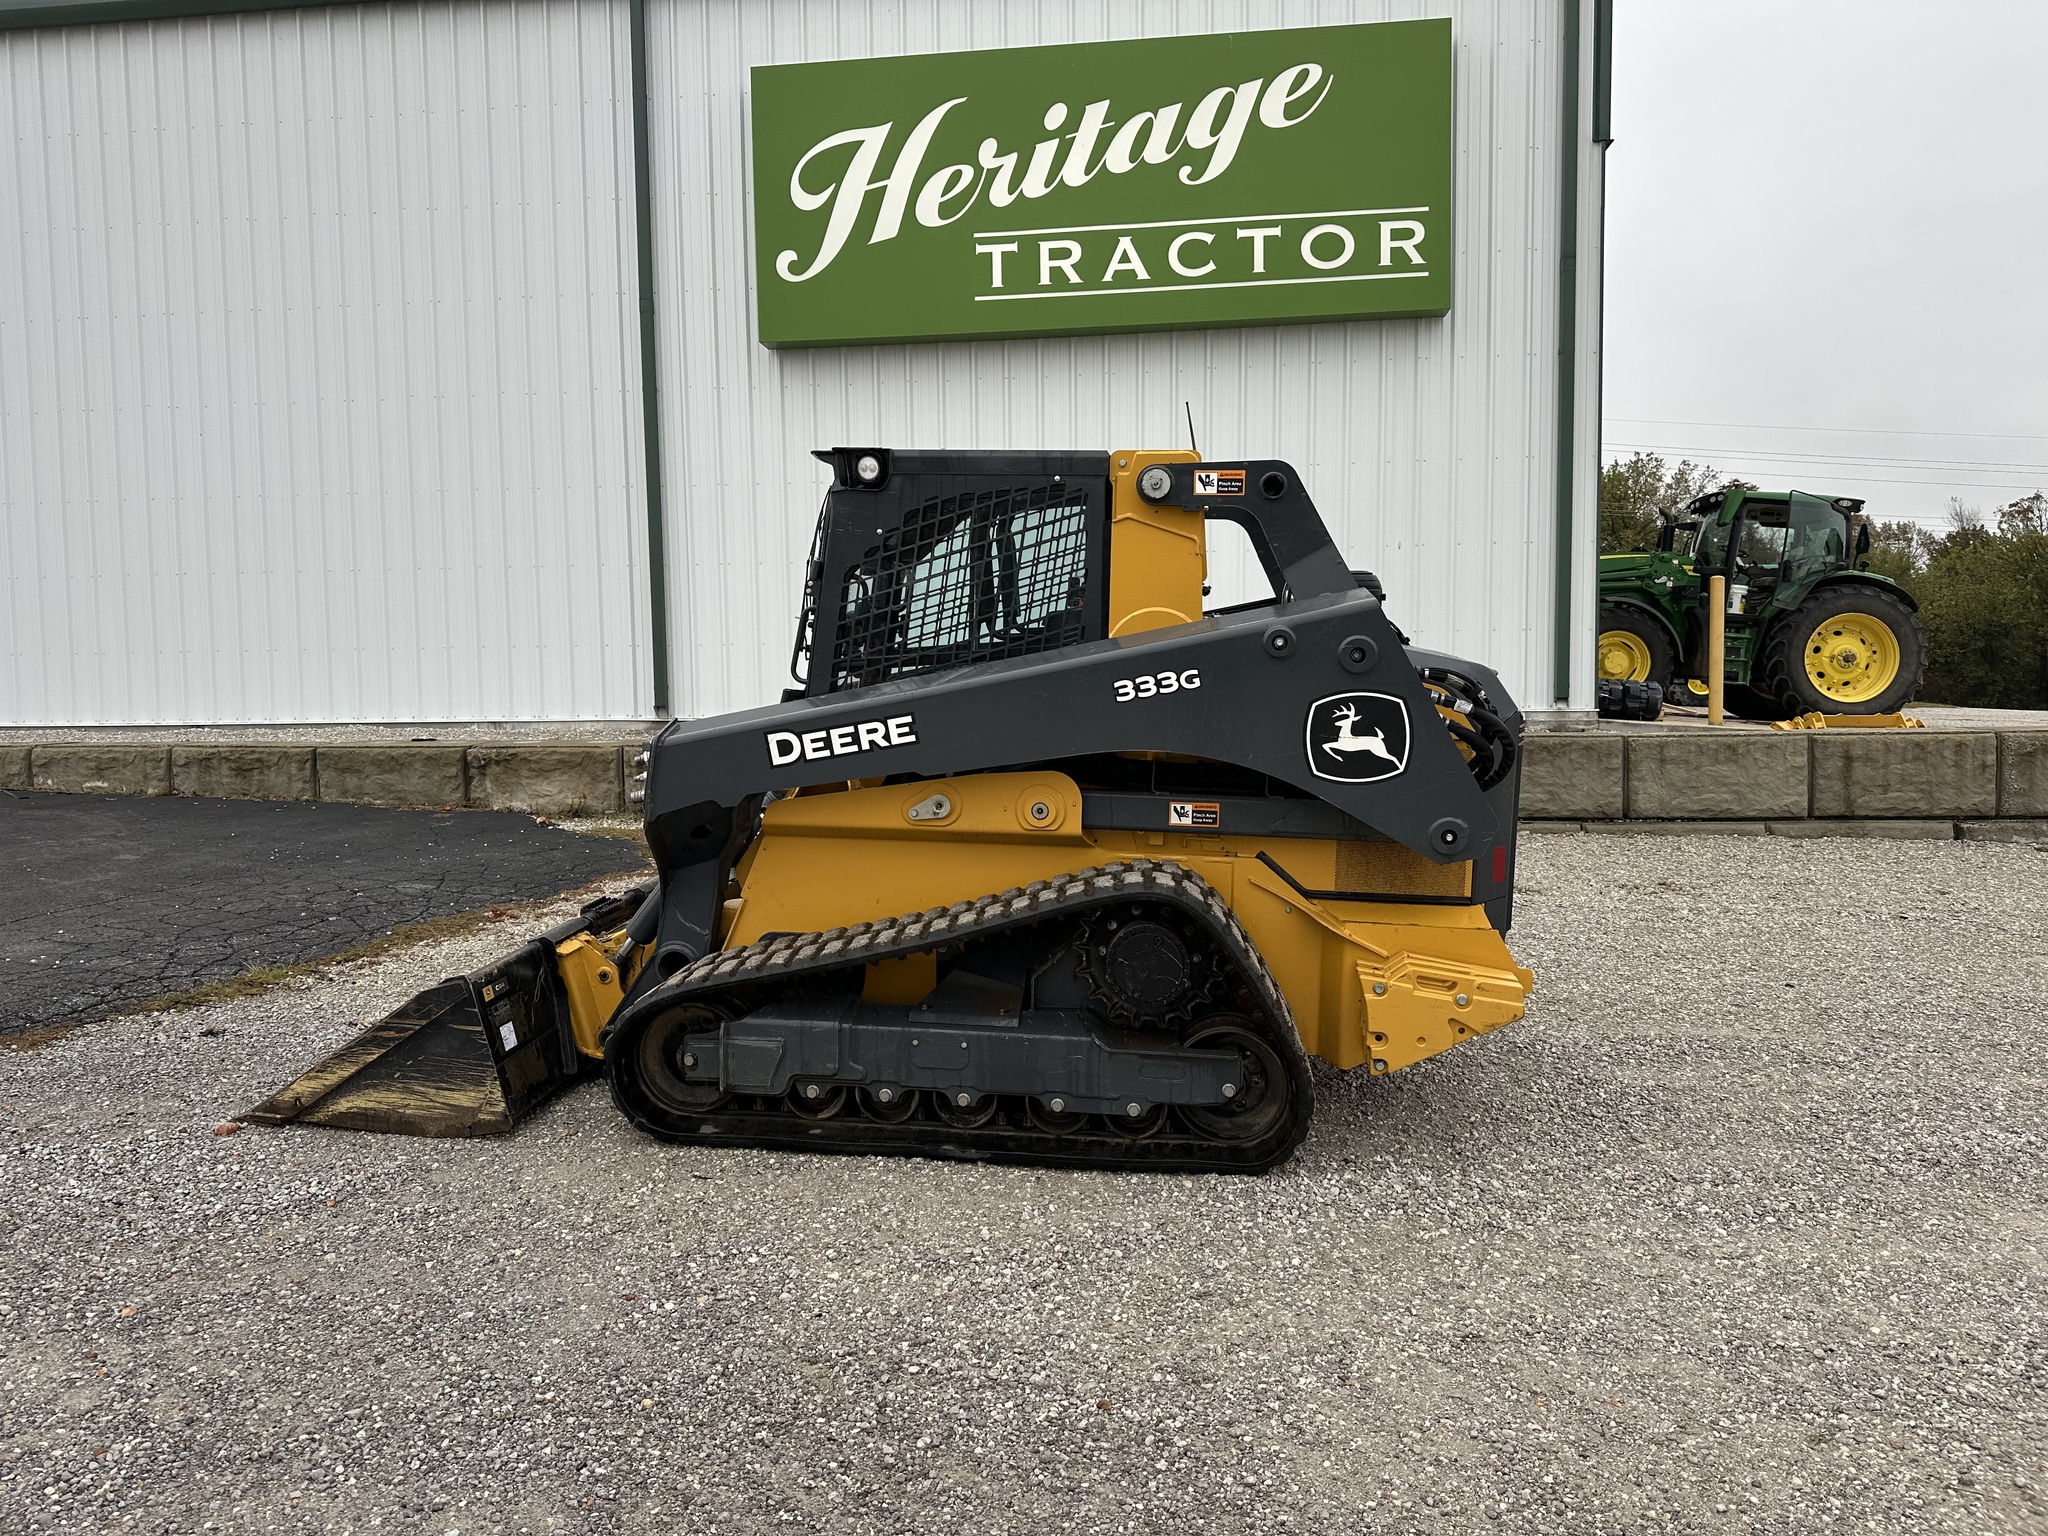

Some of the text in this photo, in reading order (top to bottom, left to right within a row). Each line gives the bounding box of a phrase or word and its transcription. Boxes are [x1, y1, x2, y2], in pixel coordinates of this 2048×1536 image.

[775, 62, 1335, 283] Heritage
[976, 220, 1428, 289] TRACTOR
[1113, 669, 1201, 702] 333G
[767, 715, 917, 766] DEERE
